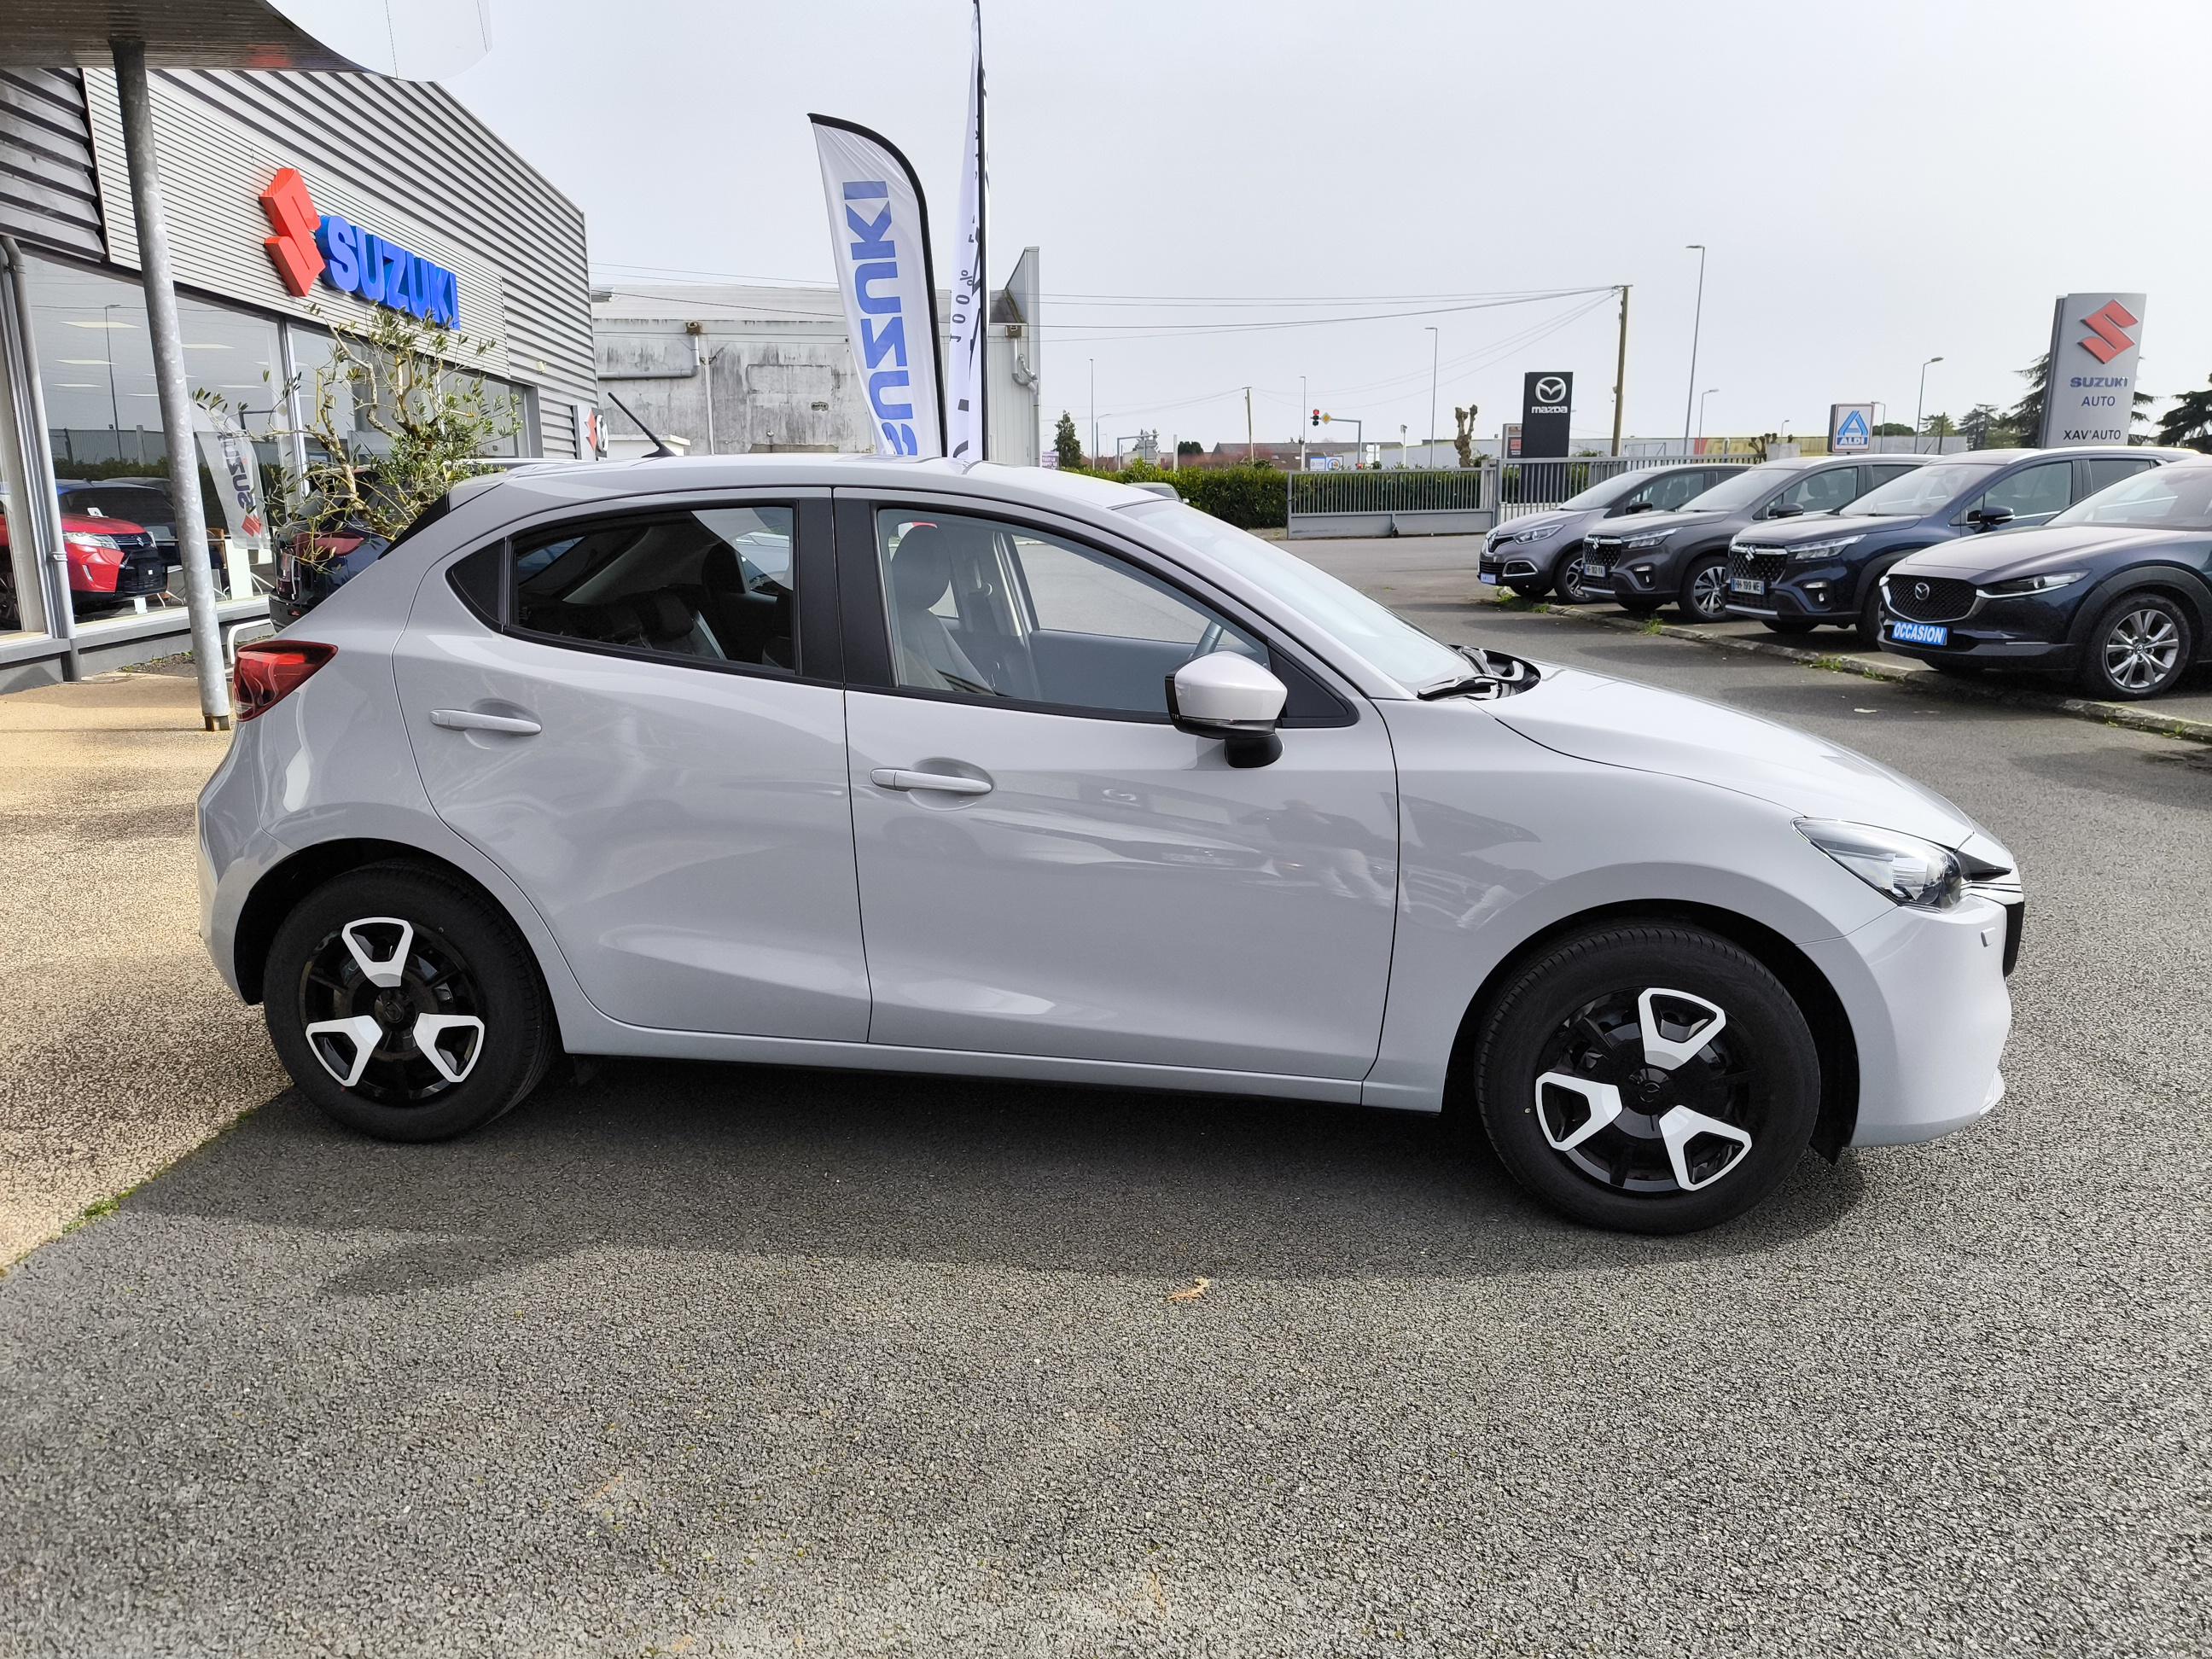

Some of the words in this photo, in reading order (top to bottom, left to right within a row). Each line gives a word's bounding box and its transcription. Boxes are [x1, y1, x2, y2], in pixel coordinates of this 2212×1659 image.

[316, 215, 461, 331] SUZUKI
[2069, 376, 2128, 388] SUZUKI
[2081, 396, 2116, 406] AUTO
[2063, 429, 2122, 440] XAV'AUTO
[1837, 436, 1866, 445] ALDI
[1894, 622, 1944, 643] OCCASION
